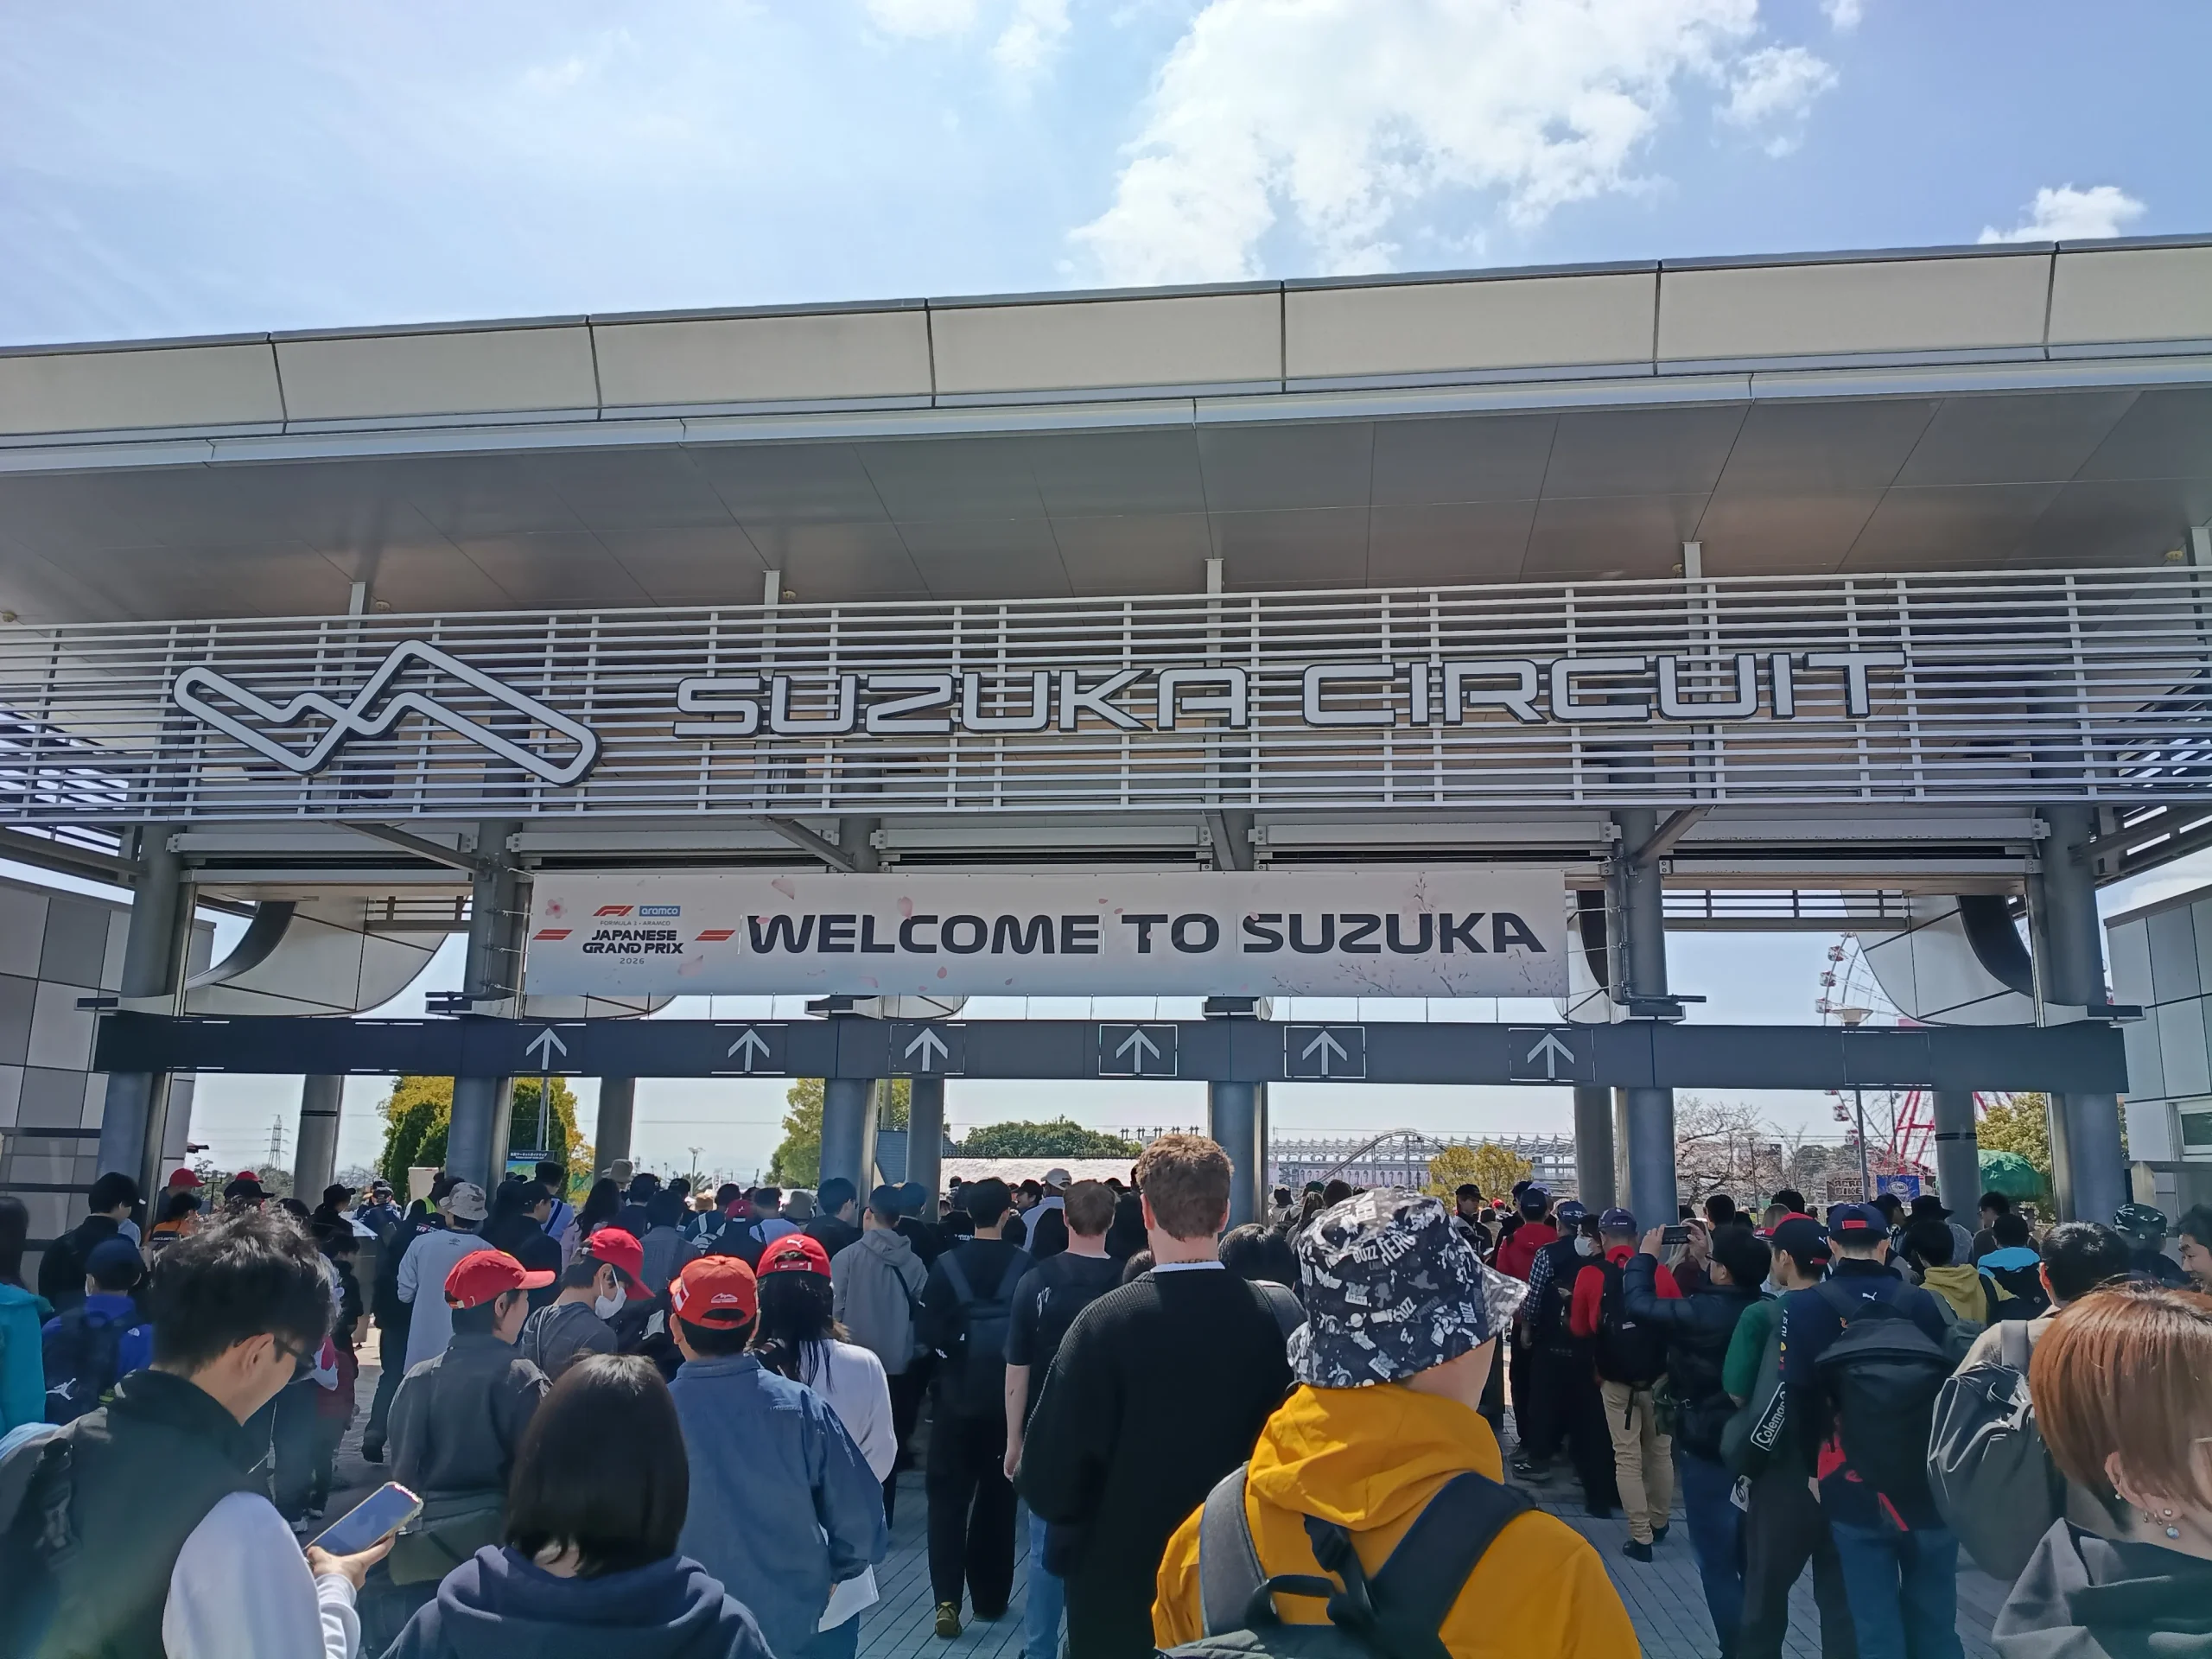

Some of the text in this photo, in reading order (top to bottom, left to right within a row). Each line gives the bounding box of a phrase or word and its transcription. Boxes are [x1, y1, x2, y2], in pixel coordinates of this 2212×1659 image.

[672, 650, 1907, 739] SUZUKA CIRCUIT
[591, 930, 677, 941] JAPANESE
[747, 912, 1548, 954] WELCOME TO SUZUKA
[582, 943, 684, 954] GRAND PRIX
[1353, 1244, 1378, 1264] BUZZ
[1459, 1301, 1478, 1324] BUZZ
